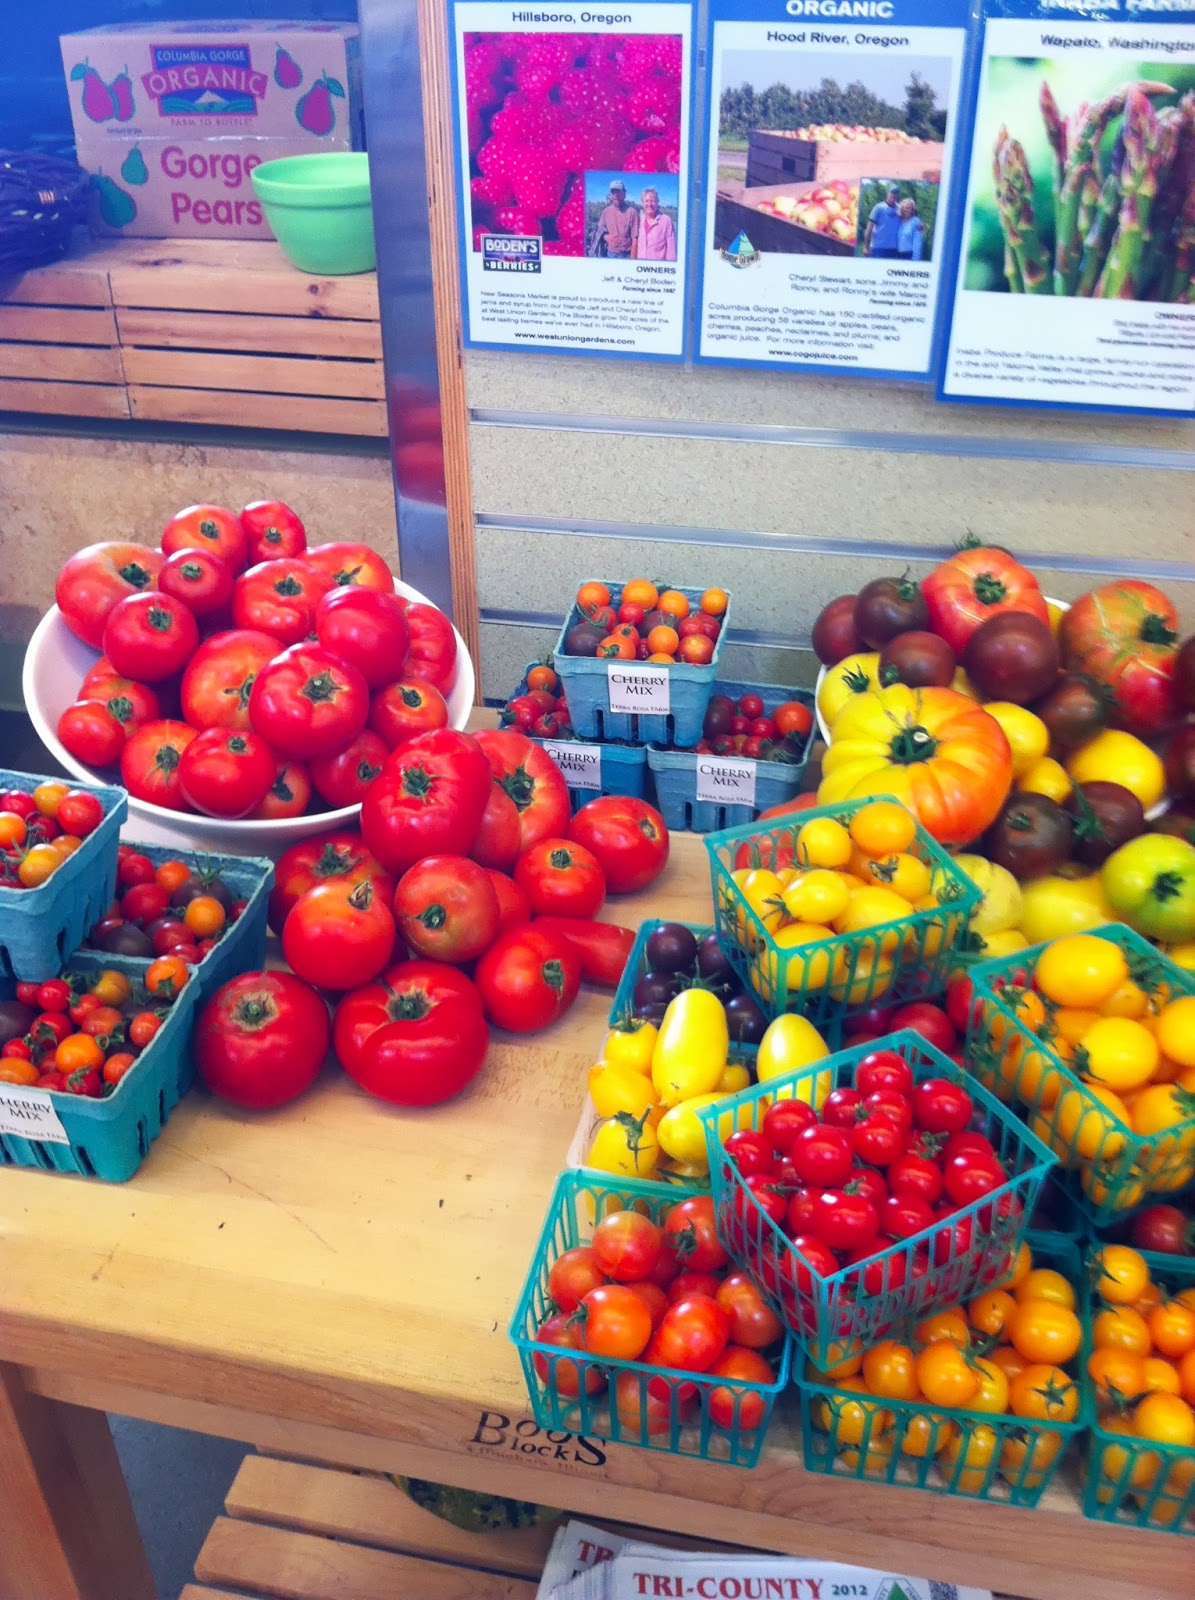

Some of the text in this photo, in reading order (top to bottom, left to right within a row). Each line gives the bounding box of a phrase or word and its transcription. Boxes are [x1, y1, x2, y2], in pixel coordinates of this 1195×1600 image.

[785, 0, 895, 18] ORGANIC
[512, 11, 632, 25] Hillsboro, Oregon
[767, 31, 909, 47] Hood River, Oregon
[157, 50, 246, 62] COLUMBIA GORGE
[149, 66, 262, 95] ORGANIC
[161, 145, 262, 188] Gorge
[171, 192, 263, 225] Pears
[485, 238, 538, 253] BODEN'S
[490, 261, 534, 271] BERRIES
[636, 265, 676, 274] OWNERS
[886, 269, 930, 279] OWNERS
[624, 277, 649, 285] Cheryl
[788, 273, 817, 282] Cheryl
[911, 281, 929, 289] and
[497, 291, 526, 299] Seasons
[616, 306, 638, 314] Cheryl
[708, 302, 750, 312] Columbia
[752, 304, 779, 314] Gorge
[782, 306, 816, 316] Organic
[819, 309, 835, 317] has
[733, 314, 776, 324] producing
[514, 333, 636, 345] www.westuniongardens.com
[766, 335, 781, 343] For
[833, 330, 850, 338] and
[768, 349, 858, 361] www.cogojuice.com
[611, 674, 667, 686] CHERRY
[625, 685, 653, 696] MIX
[611, 703, 631, 711] TERRA
[547, 749, 598, 764] CHERRY
[560, 761, 586, 772] MIX
[700, 764, 753, 779] CHERRY
[712, 776, 739, 788] MIX
[0, 1097, 51, 1114] HERRY
[9, 1107, 42, 1121] MIX
[632, 1572, 824, 1600] TRI-COUNTY
[831, 1584, 868, 1596] 2012
